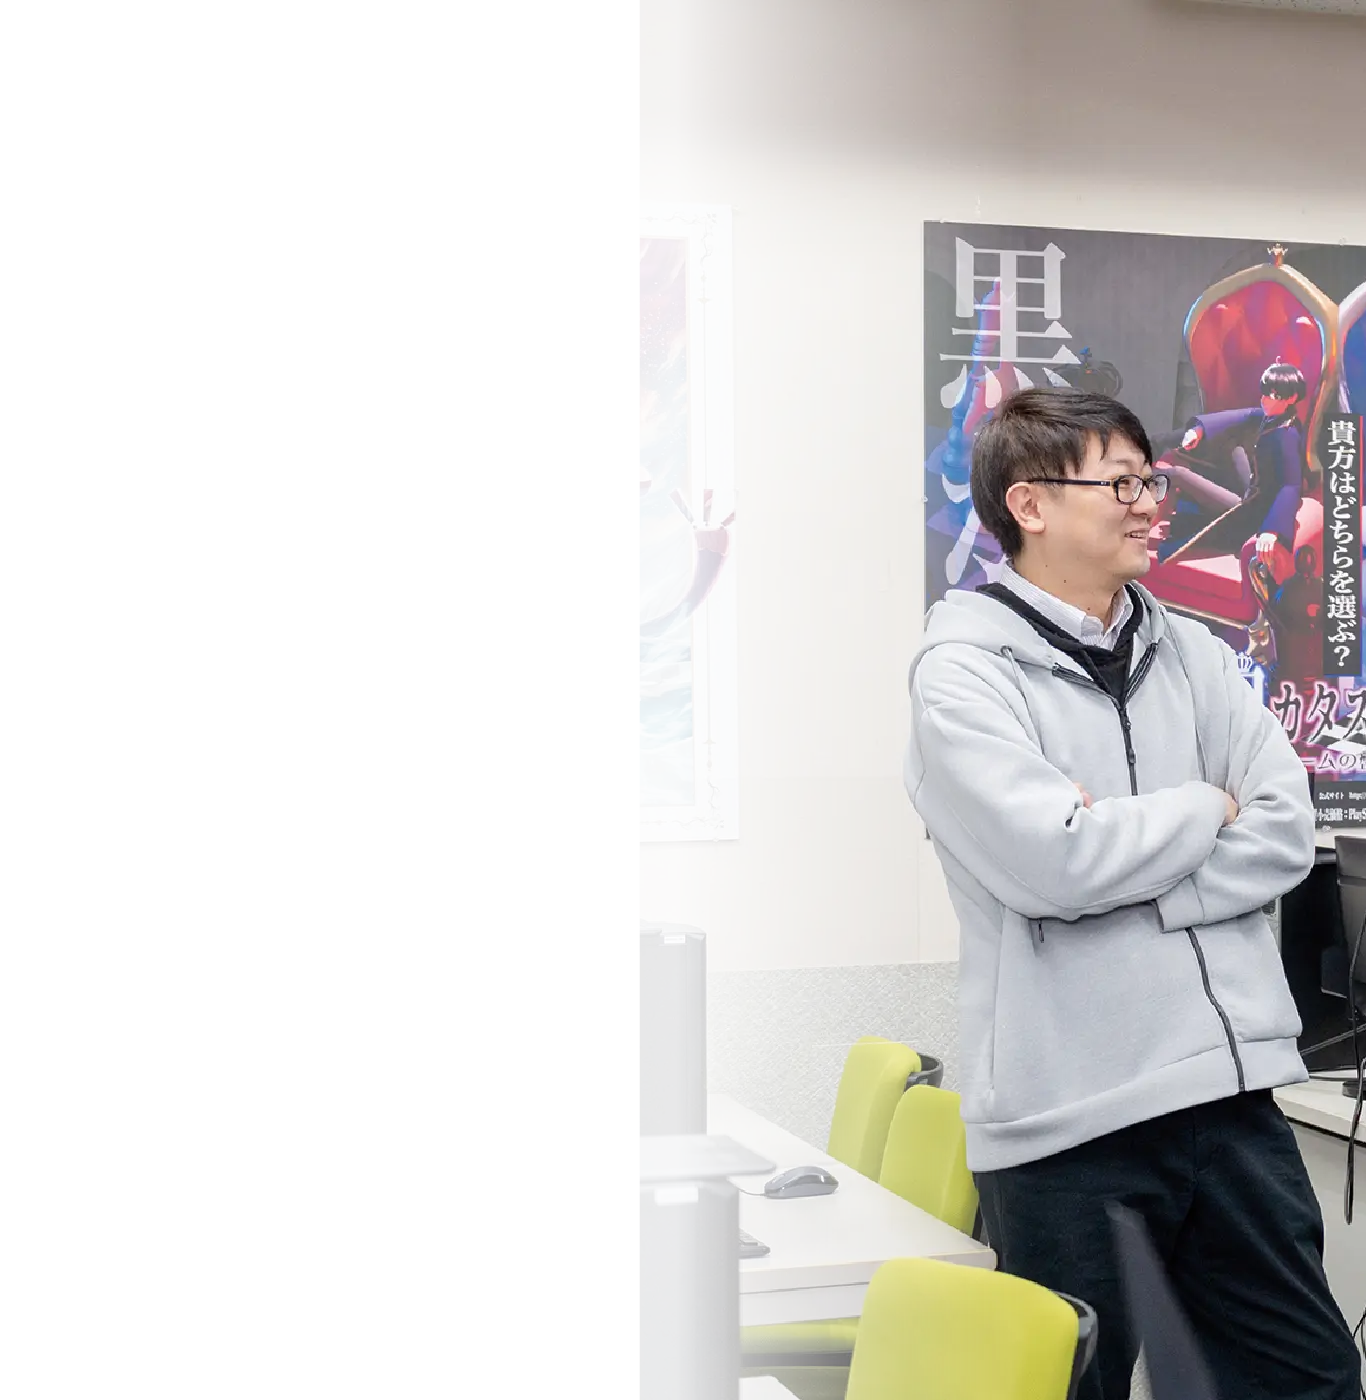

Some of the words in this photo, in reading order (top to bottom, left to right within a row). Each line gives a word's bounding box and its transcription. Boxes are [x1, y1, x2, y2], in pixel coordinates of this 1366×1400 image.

[1327, 420, 1357, 667] 貴方はどちらを選ぶ？
